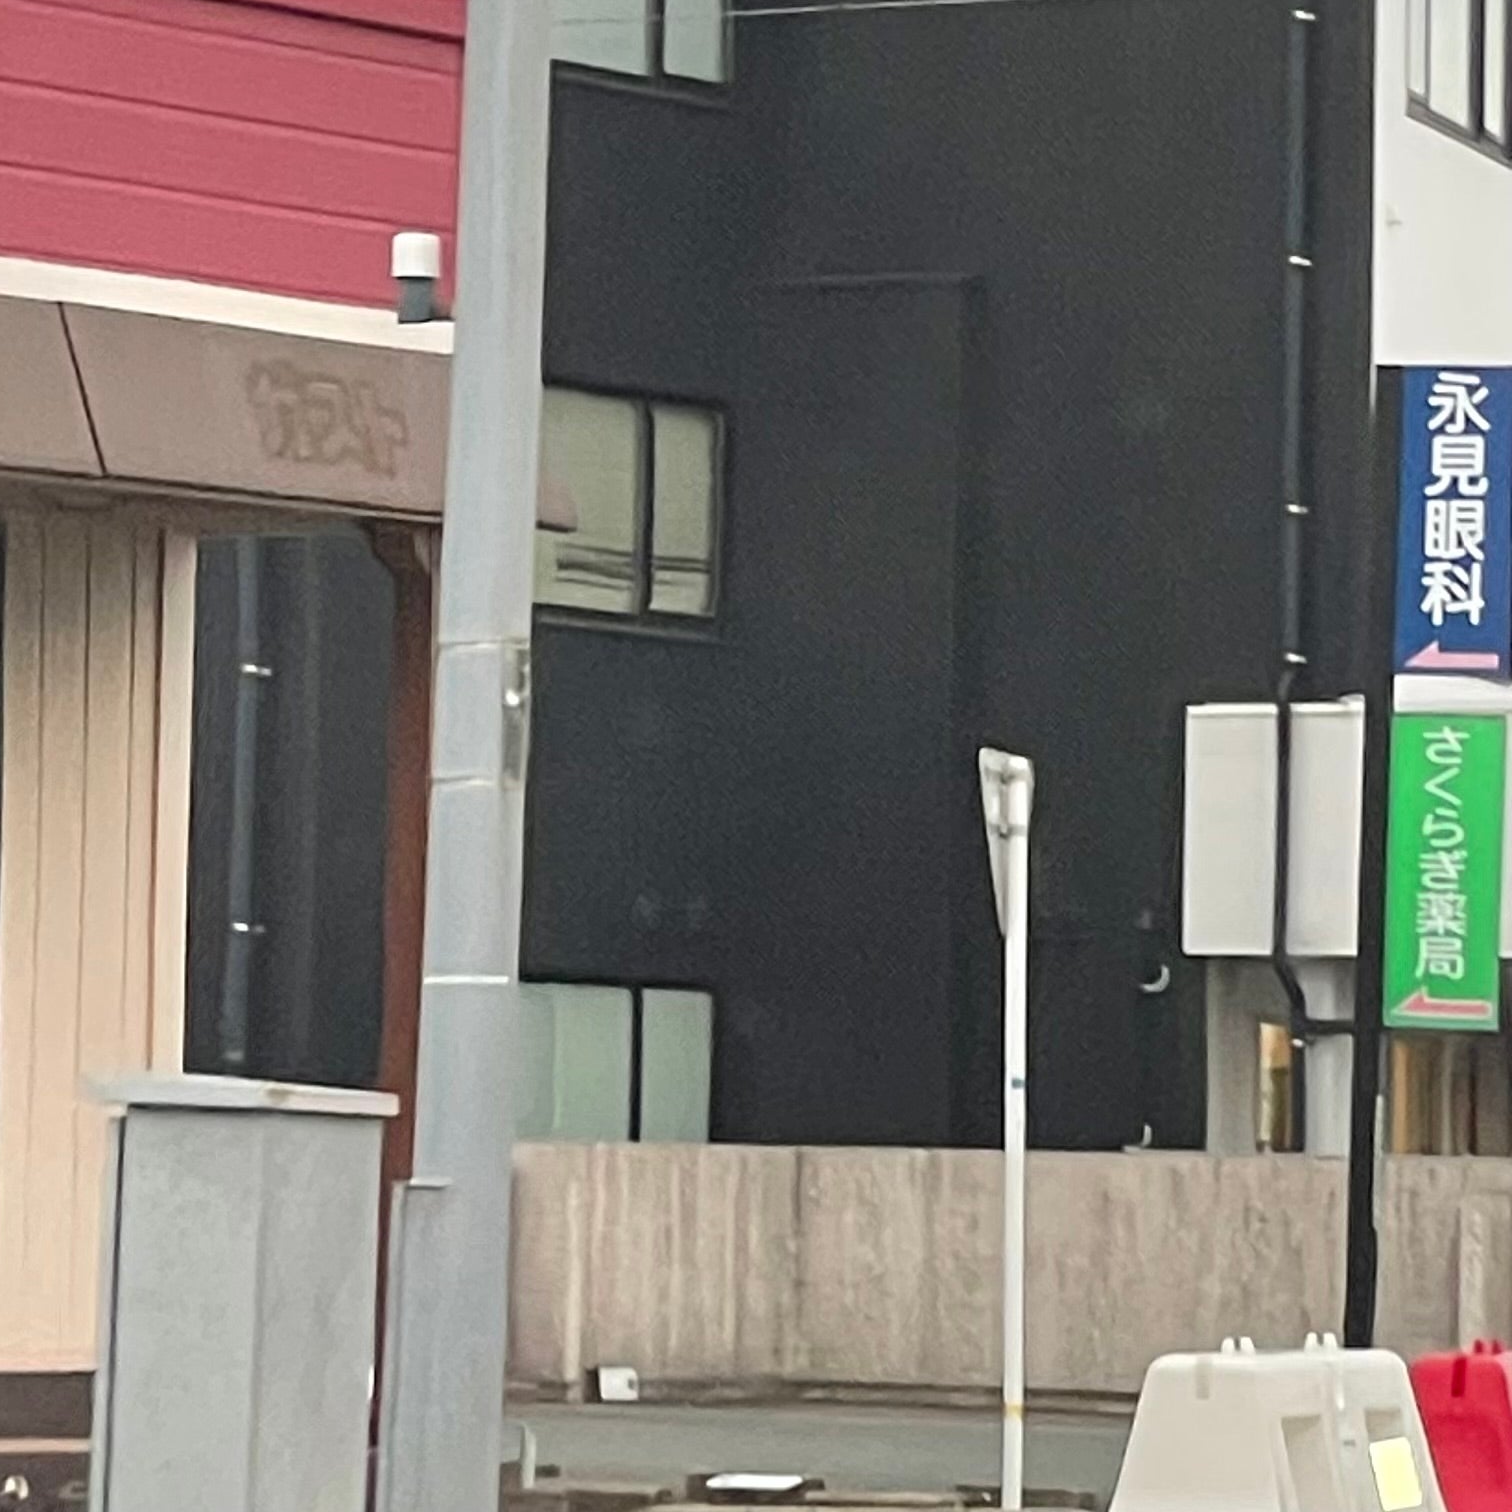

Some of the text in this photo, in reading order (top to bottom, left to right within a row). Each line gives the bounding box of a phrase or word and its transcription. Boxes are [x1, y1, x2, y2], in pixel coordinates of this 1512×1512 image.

[1420, 371, 1492, 627] 永見眼科
[1414, 725, 1470, 981] さくらぎ薬局
